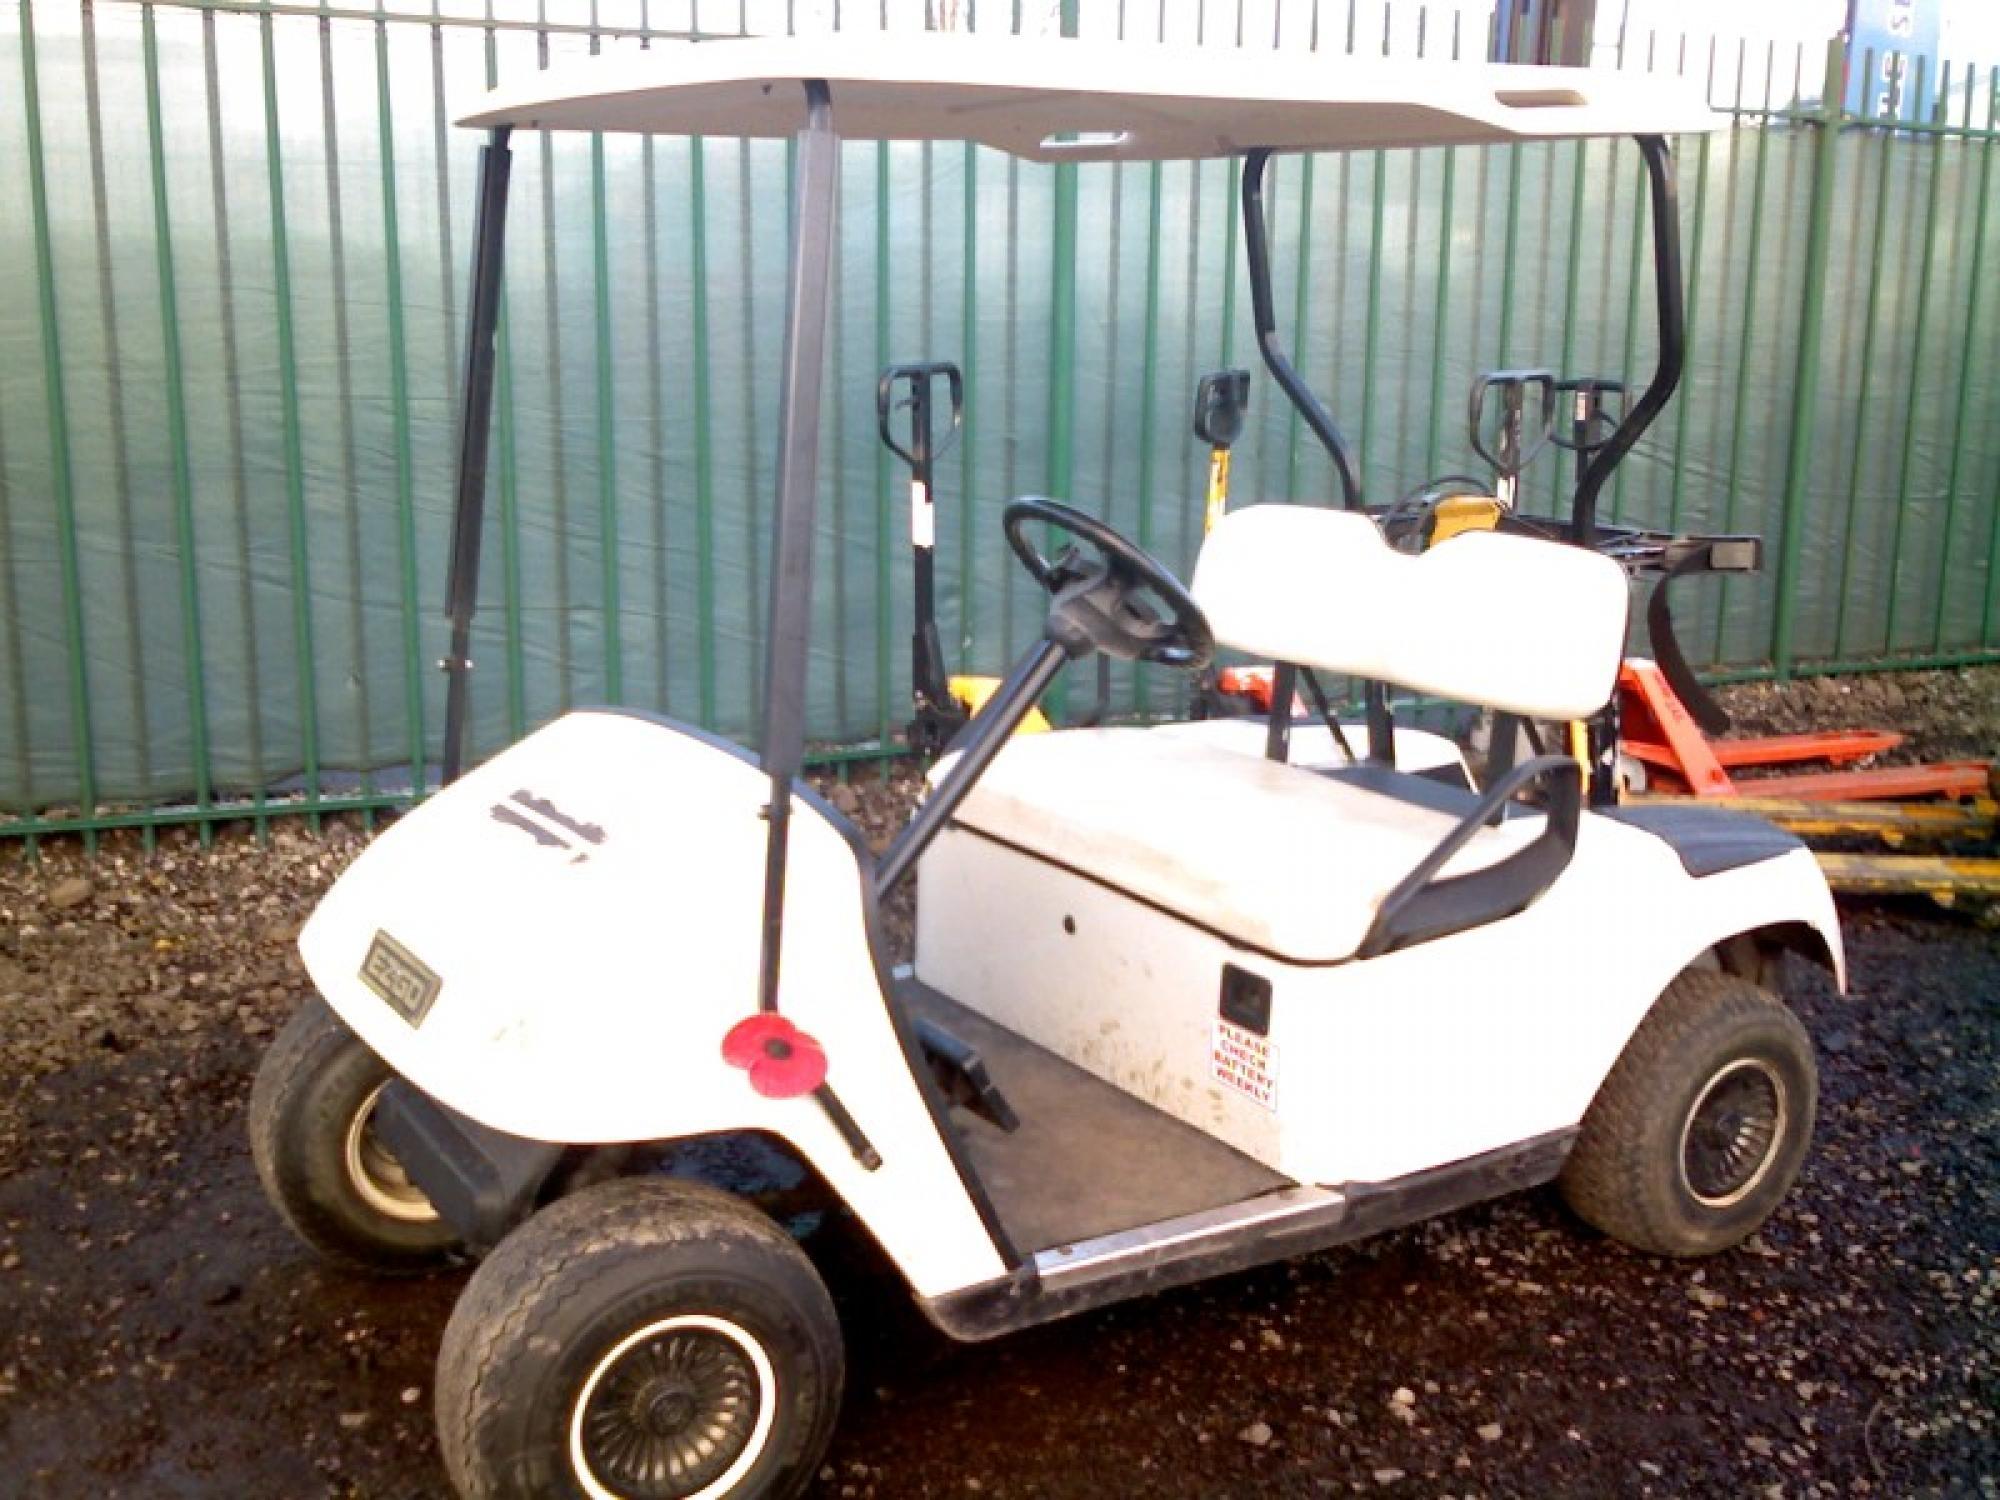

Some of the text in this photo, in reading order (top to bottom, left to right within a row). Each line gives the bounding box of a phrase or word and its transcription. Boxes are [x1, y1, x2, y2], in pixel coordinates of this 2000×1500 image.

[1219, 1023, 1270, 1058] PLEASE
[1220, 1038, 1266, 1071] CHECK
[1214, 1049, 1273, 1090] BATTERY
[1216, 1068, 1270, 1101] WEEKLY
